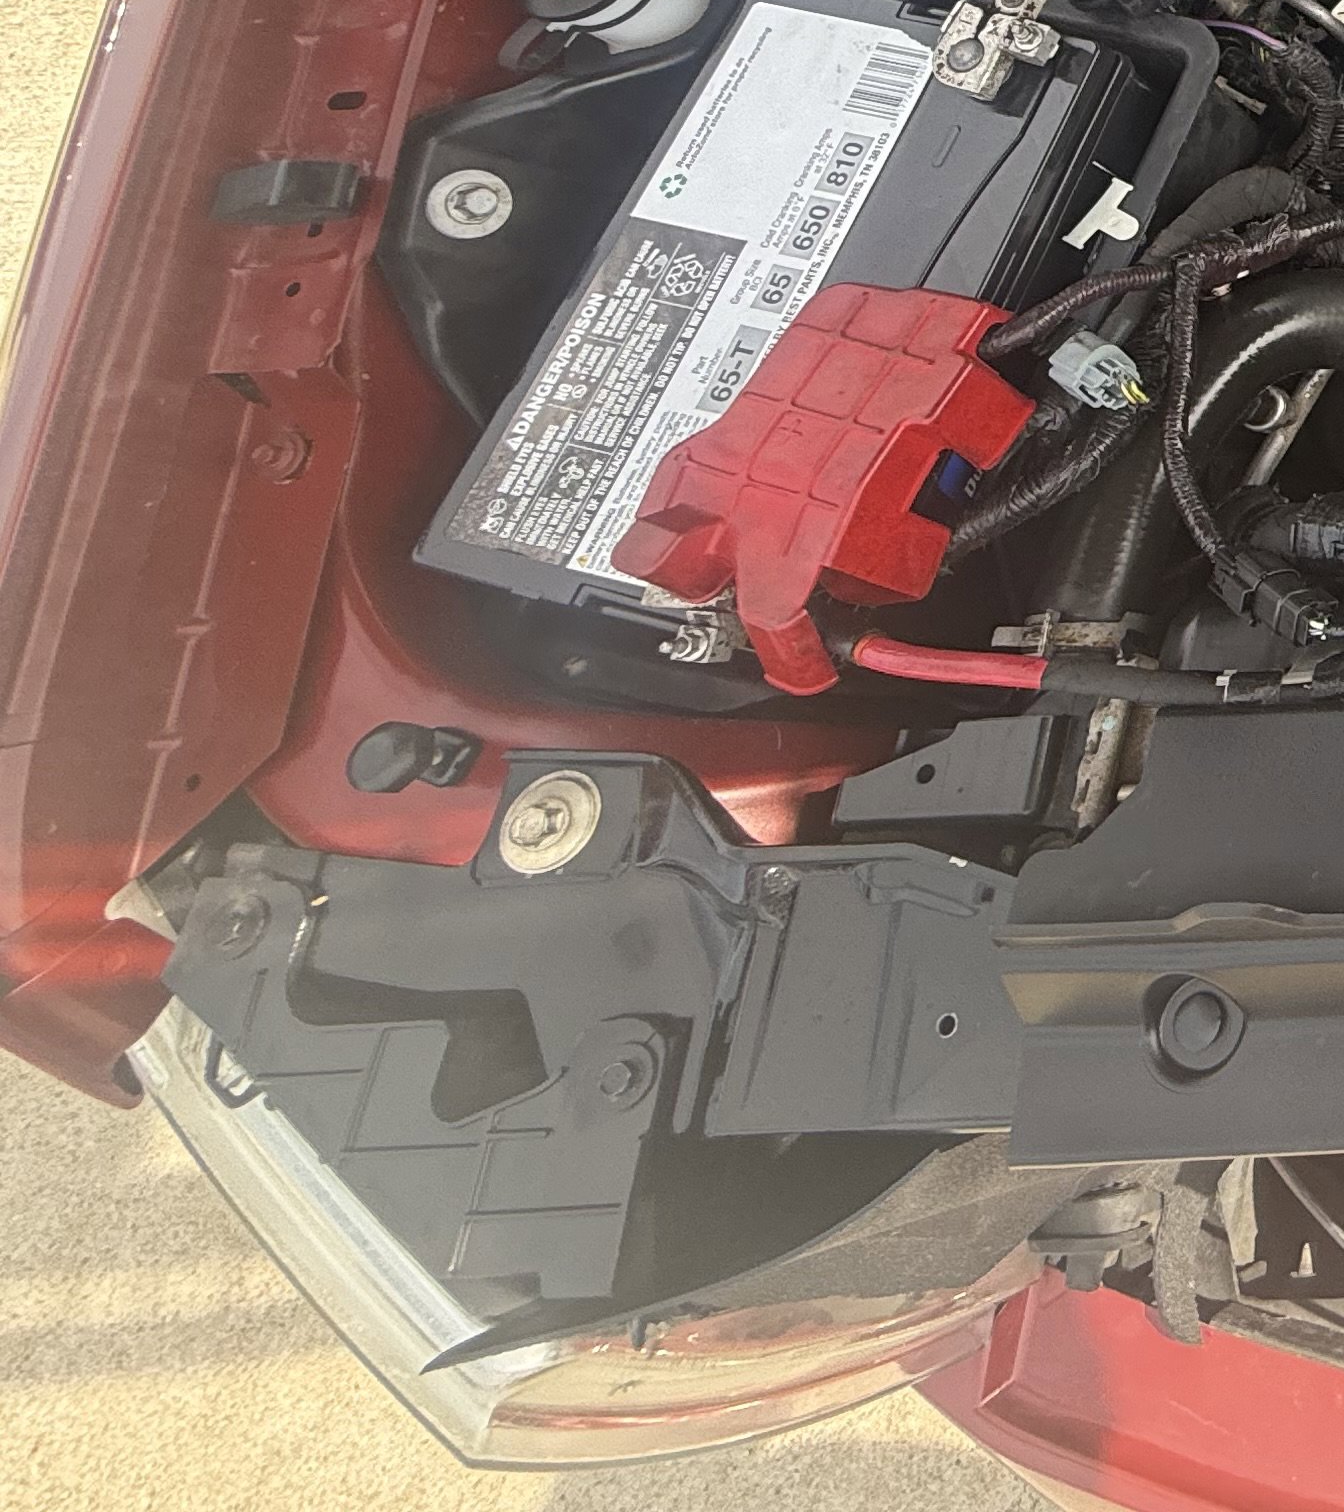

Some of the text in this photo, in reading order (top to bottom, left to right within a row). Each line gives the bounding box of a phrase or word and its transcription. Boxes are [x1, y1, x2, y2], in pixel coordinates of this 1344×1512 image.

[721, 91, 735, 104] for
[728, 63, 751, 91] proper
[674, 138, 698, 167] Return
[692, 115, 711, 137] used
[726, 68, 738, 77] to
[792, 126, 834, 188] Cranking Amps
[824, 140, 865, 187] 810
[759, 190, 799, 249] Cold Cranking
[781, 295, 804, 323] BEST
[796, 257, 824, 294] PARTS,
[831, 177, 866, 229] MEMPHIS,
[858, 162, 874, 178] TN
[867, 131, 891, 161] 38103
[789, 202, 832, 252] 650
[728, 257, 762, 305] Group Size
[758, 271, 793, 305] 65
[696, 289, 716, 310] OPEN
[687, 310, 704, 326] NOT
[680, 326, 696, 338] DO
[512, 291, 606, 435] DANGER/POISON
[661, 355, 680, 374] NOT
[690, 355, 709, 374] Part
[706, 338, 758, 403] 65-T
[551, 382, 573, 401] NO
[653, 374, 669, 388] DO
[620, 435, 636, 448] OF
[603, 448, 629, 478] REACH
[593, 478, 612, 496] THE
[585, 497, 602, 511] OF
[574, 511, 594, 531] OUT
[561, 531, 583, 555] KEEP
